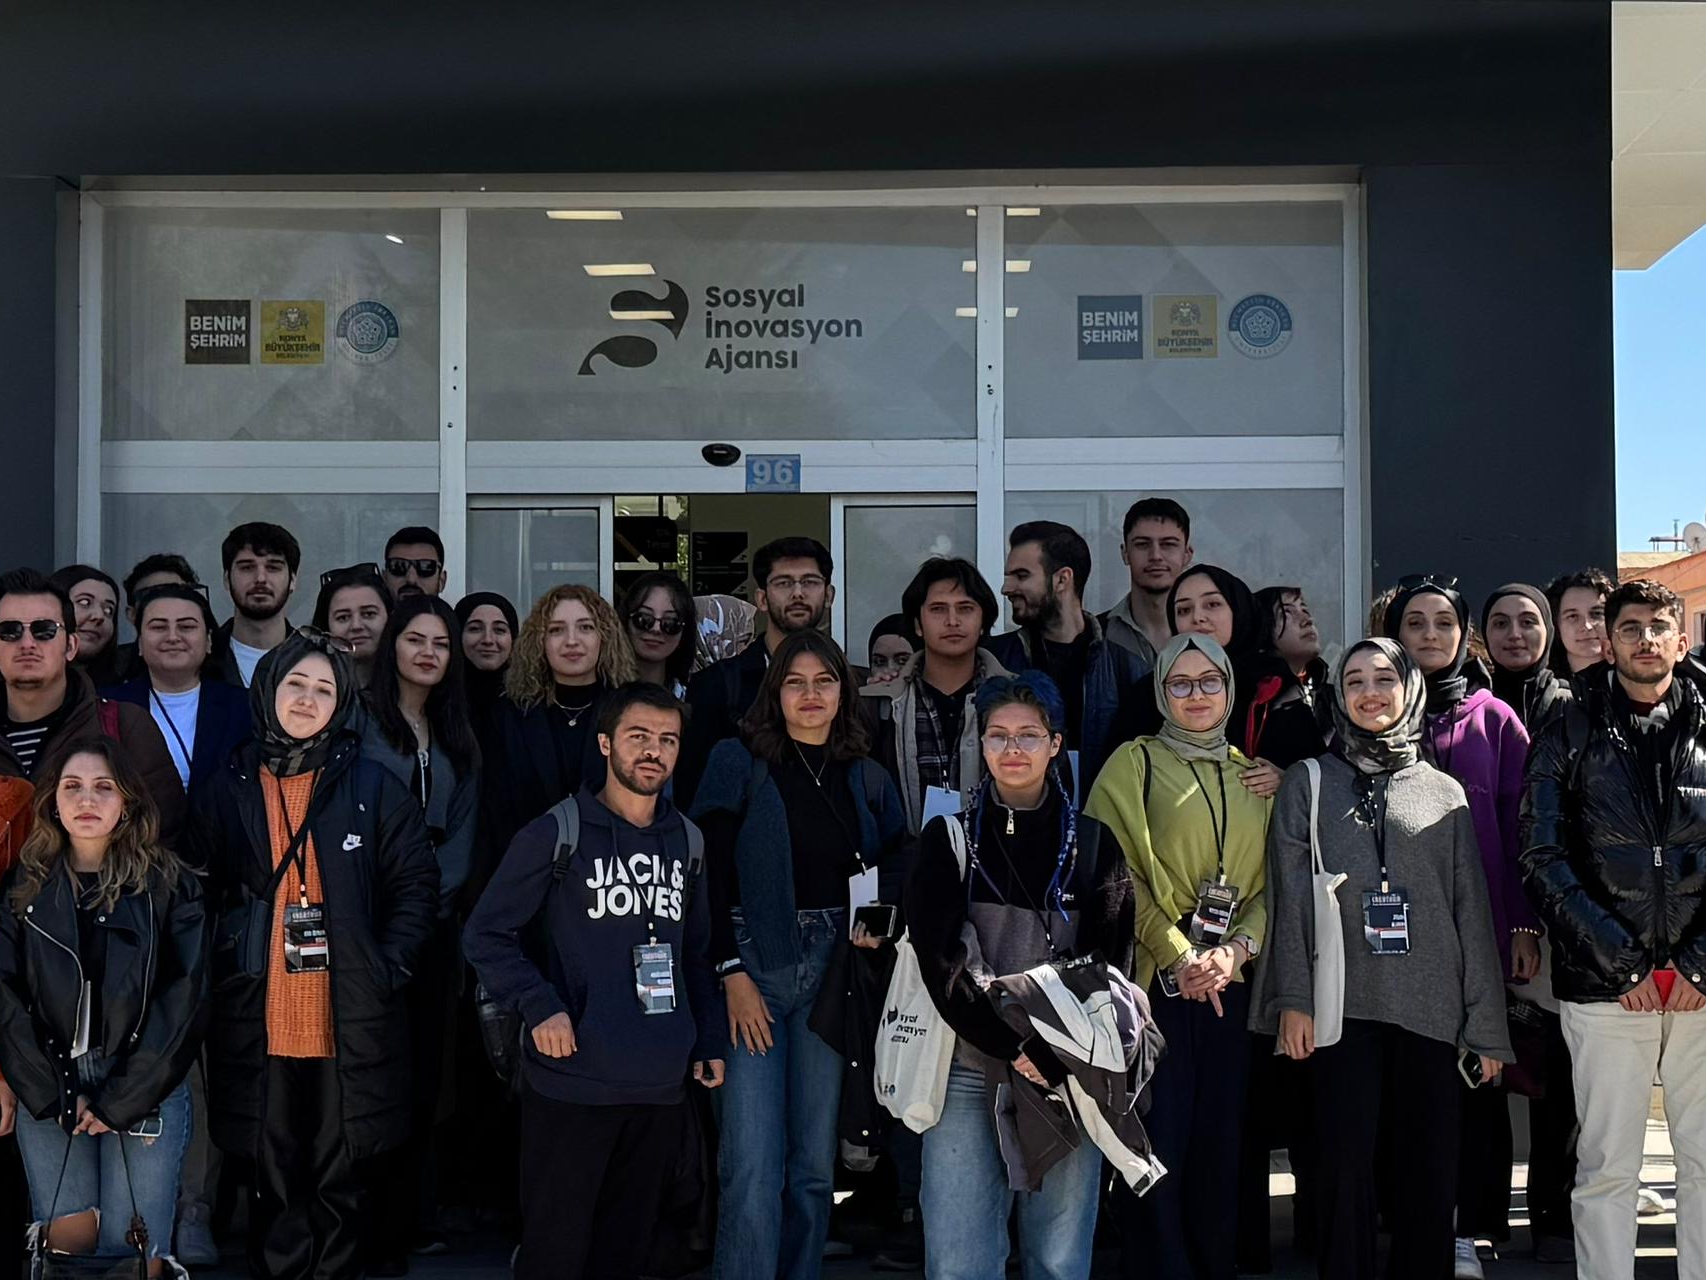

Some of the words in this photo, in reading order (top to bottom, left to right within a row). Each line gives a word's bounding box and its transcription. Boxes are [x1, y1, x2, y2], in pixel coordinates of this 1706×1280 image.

[705, 283, 804, 314] Sosyal
[190, 315, 246, 331] BENİM
[705, 310, 863, 345] İnovasyon
[1082, 311, 1138, 327] BENİM
[190, 333, 246, 350] ŞEHRİM
[1082, 329, 1138, 345] ŞEHRİM
[705, 344, 798, 374] Ajansı
[752, 460, 793, 485] 96
[586, 853, 666, 889] JACK
[671, 860, 684, 890] &
[587, 884, 683, 922] JONES
